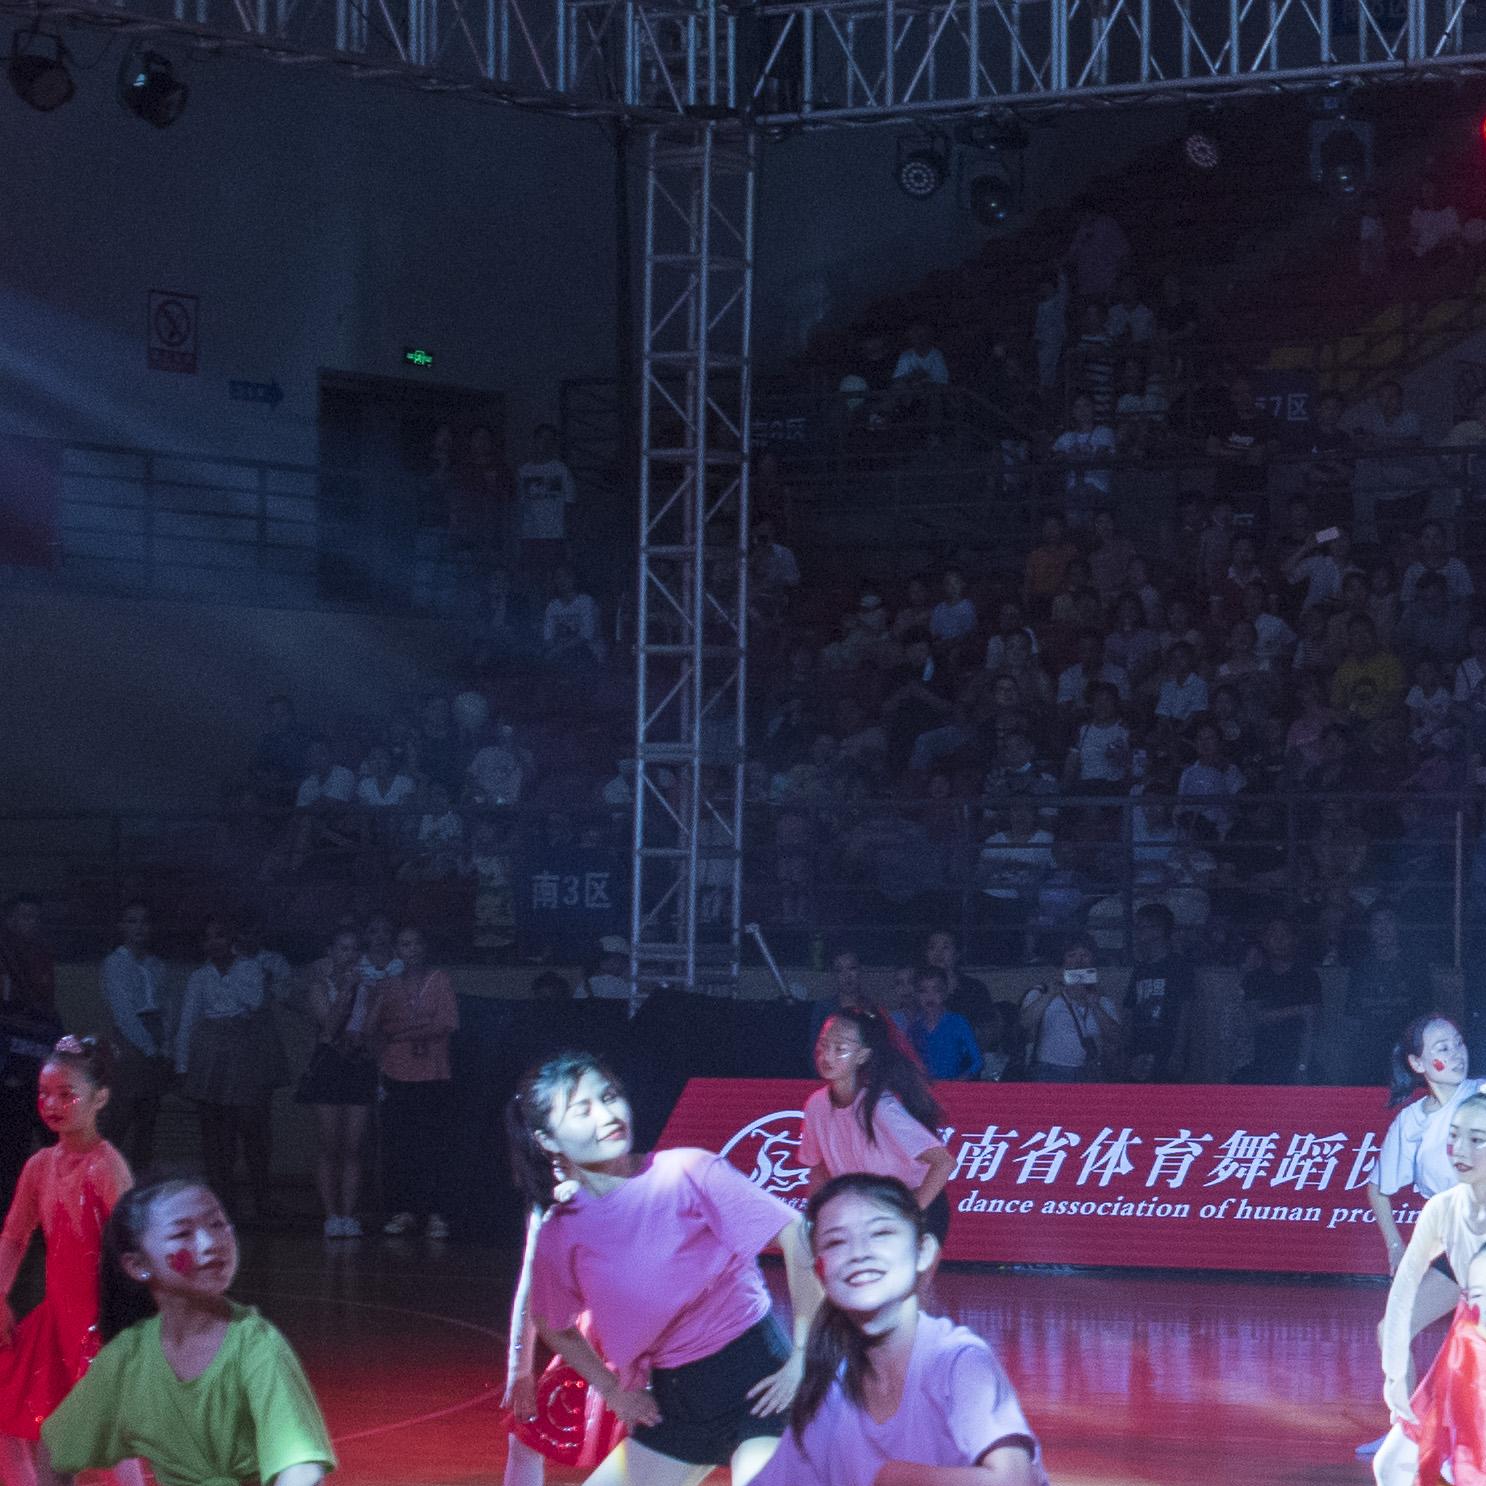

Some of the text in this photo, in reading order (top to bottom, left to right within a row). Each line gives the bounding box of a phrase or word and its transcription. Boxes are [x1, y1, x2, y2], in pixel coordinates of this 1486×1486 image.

[1255, 393, 1310, 422] 7区
[531, 870, 612, 911] 南3区
[938, 1125, 1382, 1191] 南省体育舞蹈
[958, 1190, 1422, 1228] dance association of hunan proin
